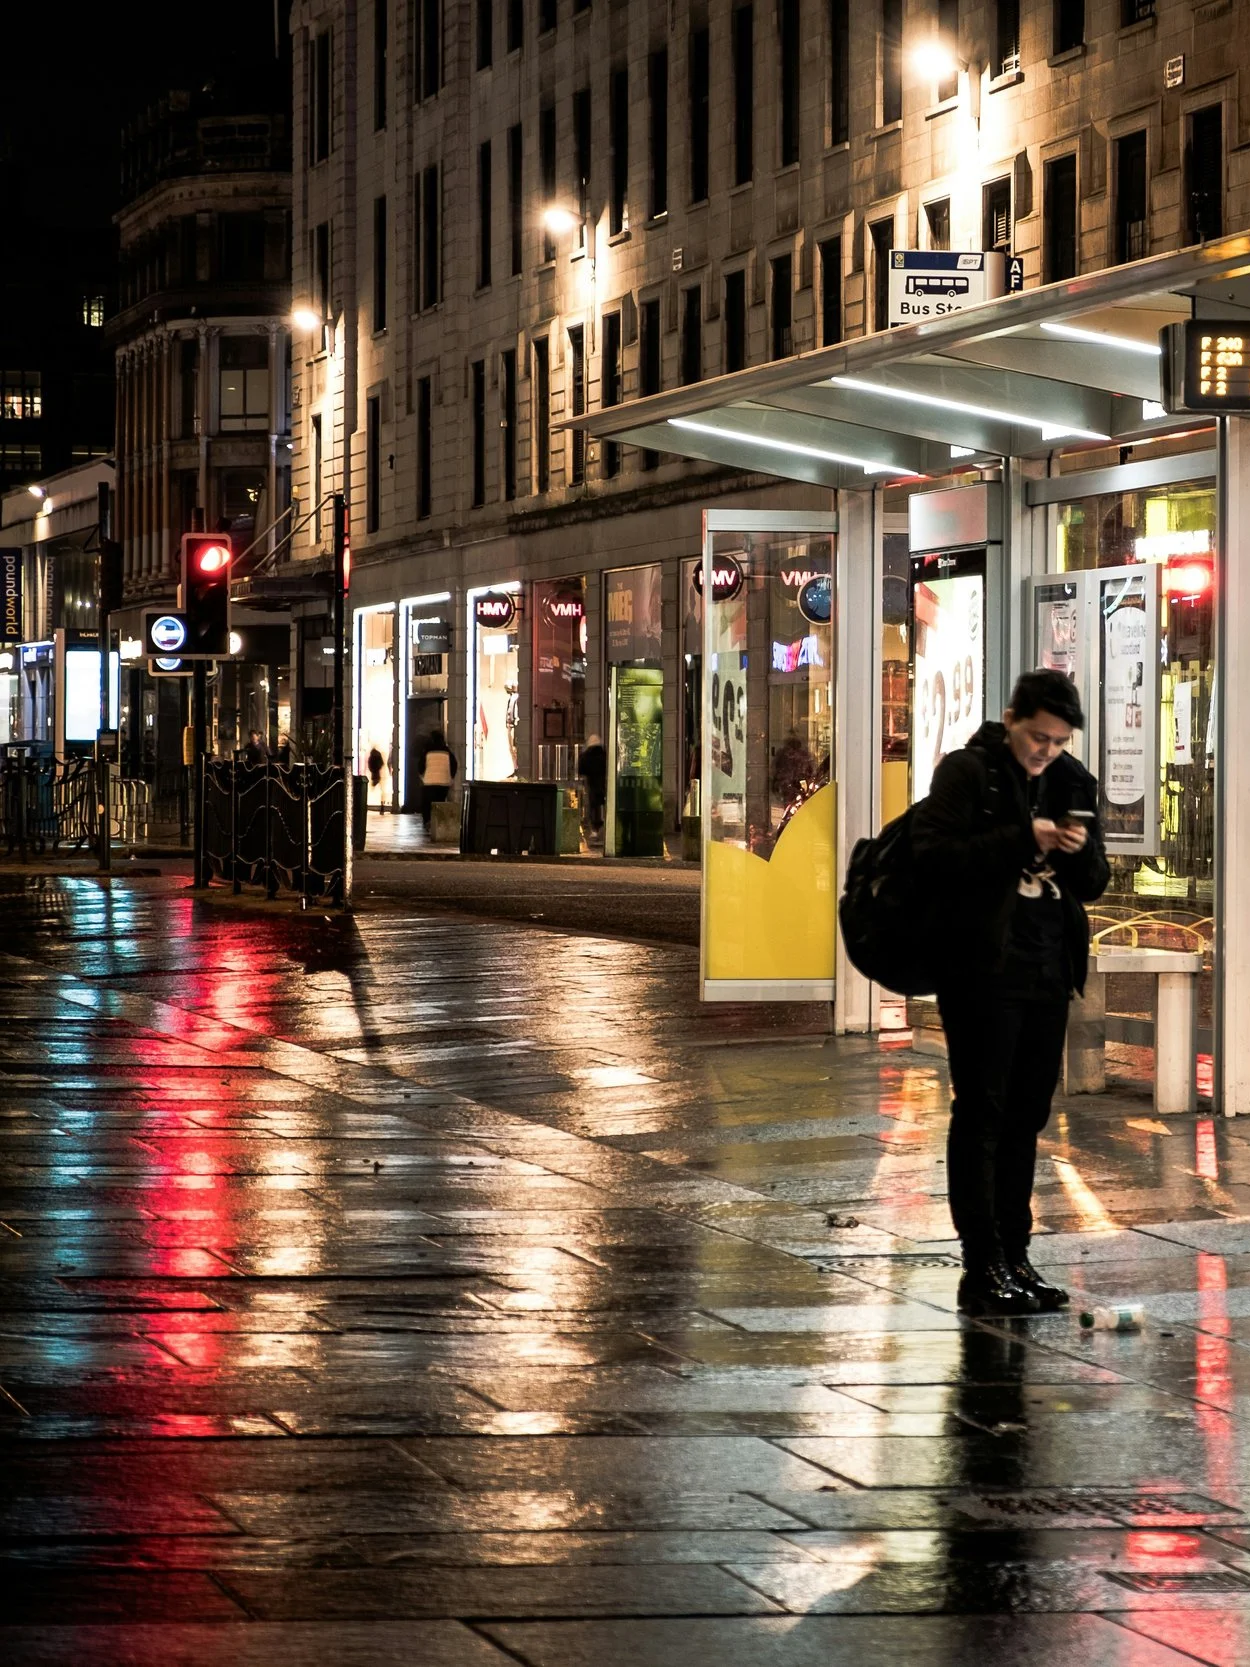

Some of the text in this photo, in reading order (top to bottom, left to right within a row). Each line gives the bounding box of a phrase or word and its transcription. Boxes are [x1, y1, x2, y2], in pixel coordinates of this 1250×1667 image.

[1010, 260, 1021, 274] A
[1011, 274, 1020, 288] F
[900, 302, 963, 315] Bus St
[1201, 336, 1212, 350] F
[1201, 351, 1212, 365] F
[1200, 366, 1212, 380] F
[1216, 366, 1227, 380] 2
[1200, 381, 1211, 395] F
[1216, 381, 1227, 395] 2
[3, 556, 18, 635] poundworld
[477, 602, 509, 616] HMV
